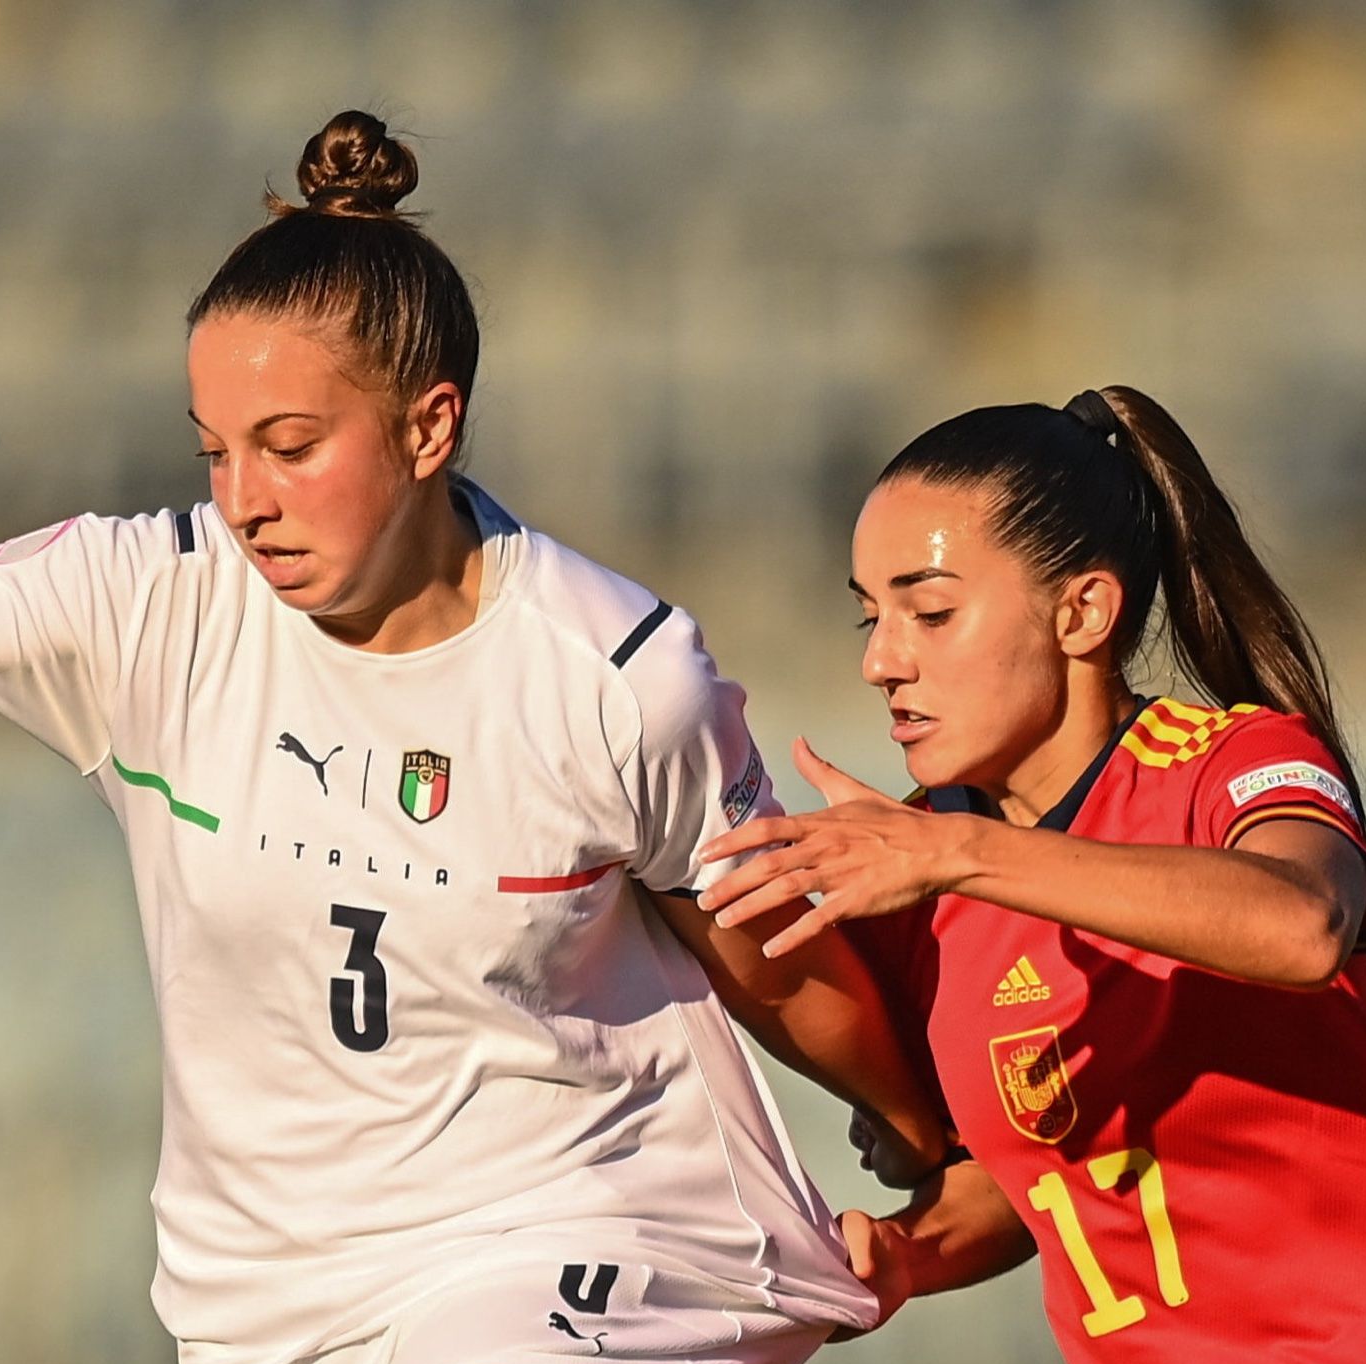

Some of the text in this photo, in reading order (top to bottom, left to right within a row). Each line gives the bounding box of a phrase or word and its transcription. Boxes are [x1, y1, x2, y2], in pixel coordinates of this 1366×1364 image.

[405, 754, 447, 770] ITALIA
[260, 834, 448, 886] ITALIA
[329, 902, 389, 1053] 3
[993, 985, 1051, 1007] adidas
[1028, 1147, 1190, 1338] 17
